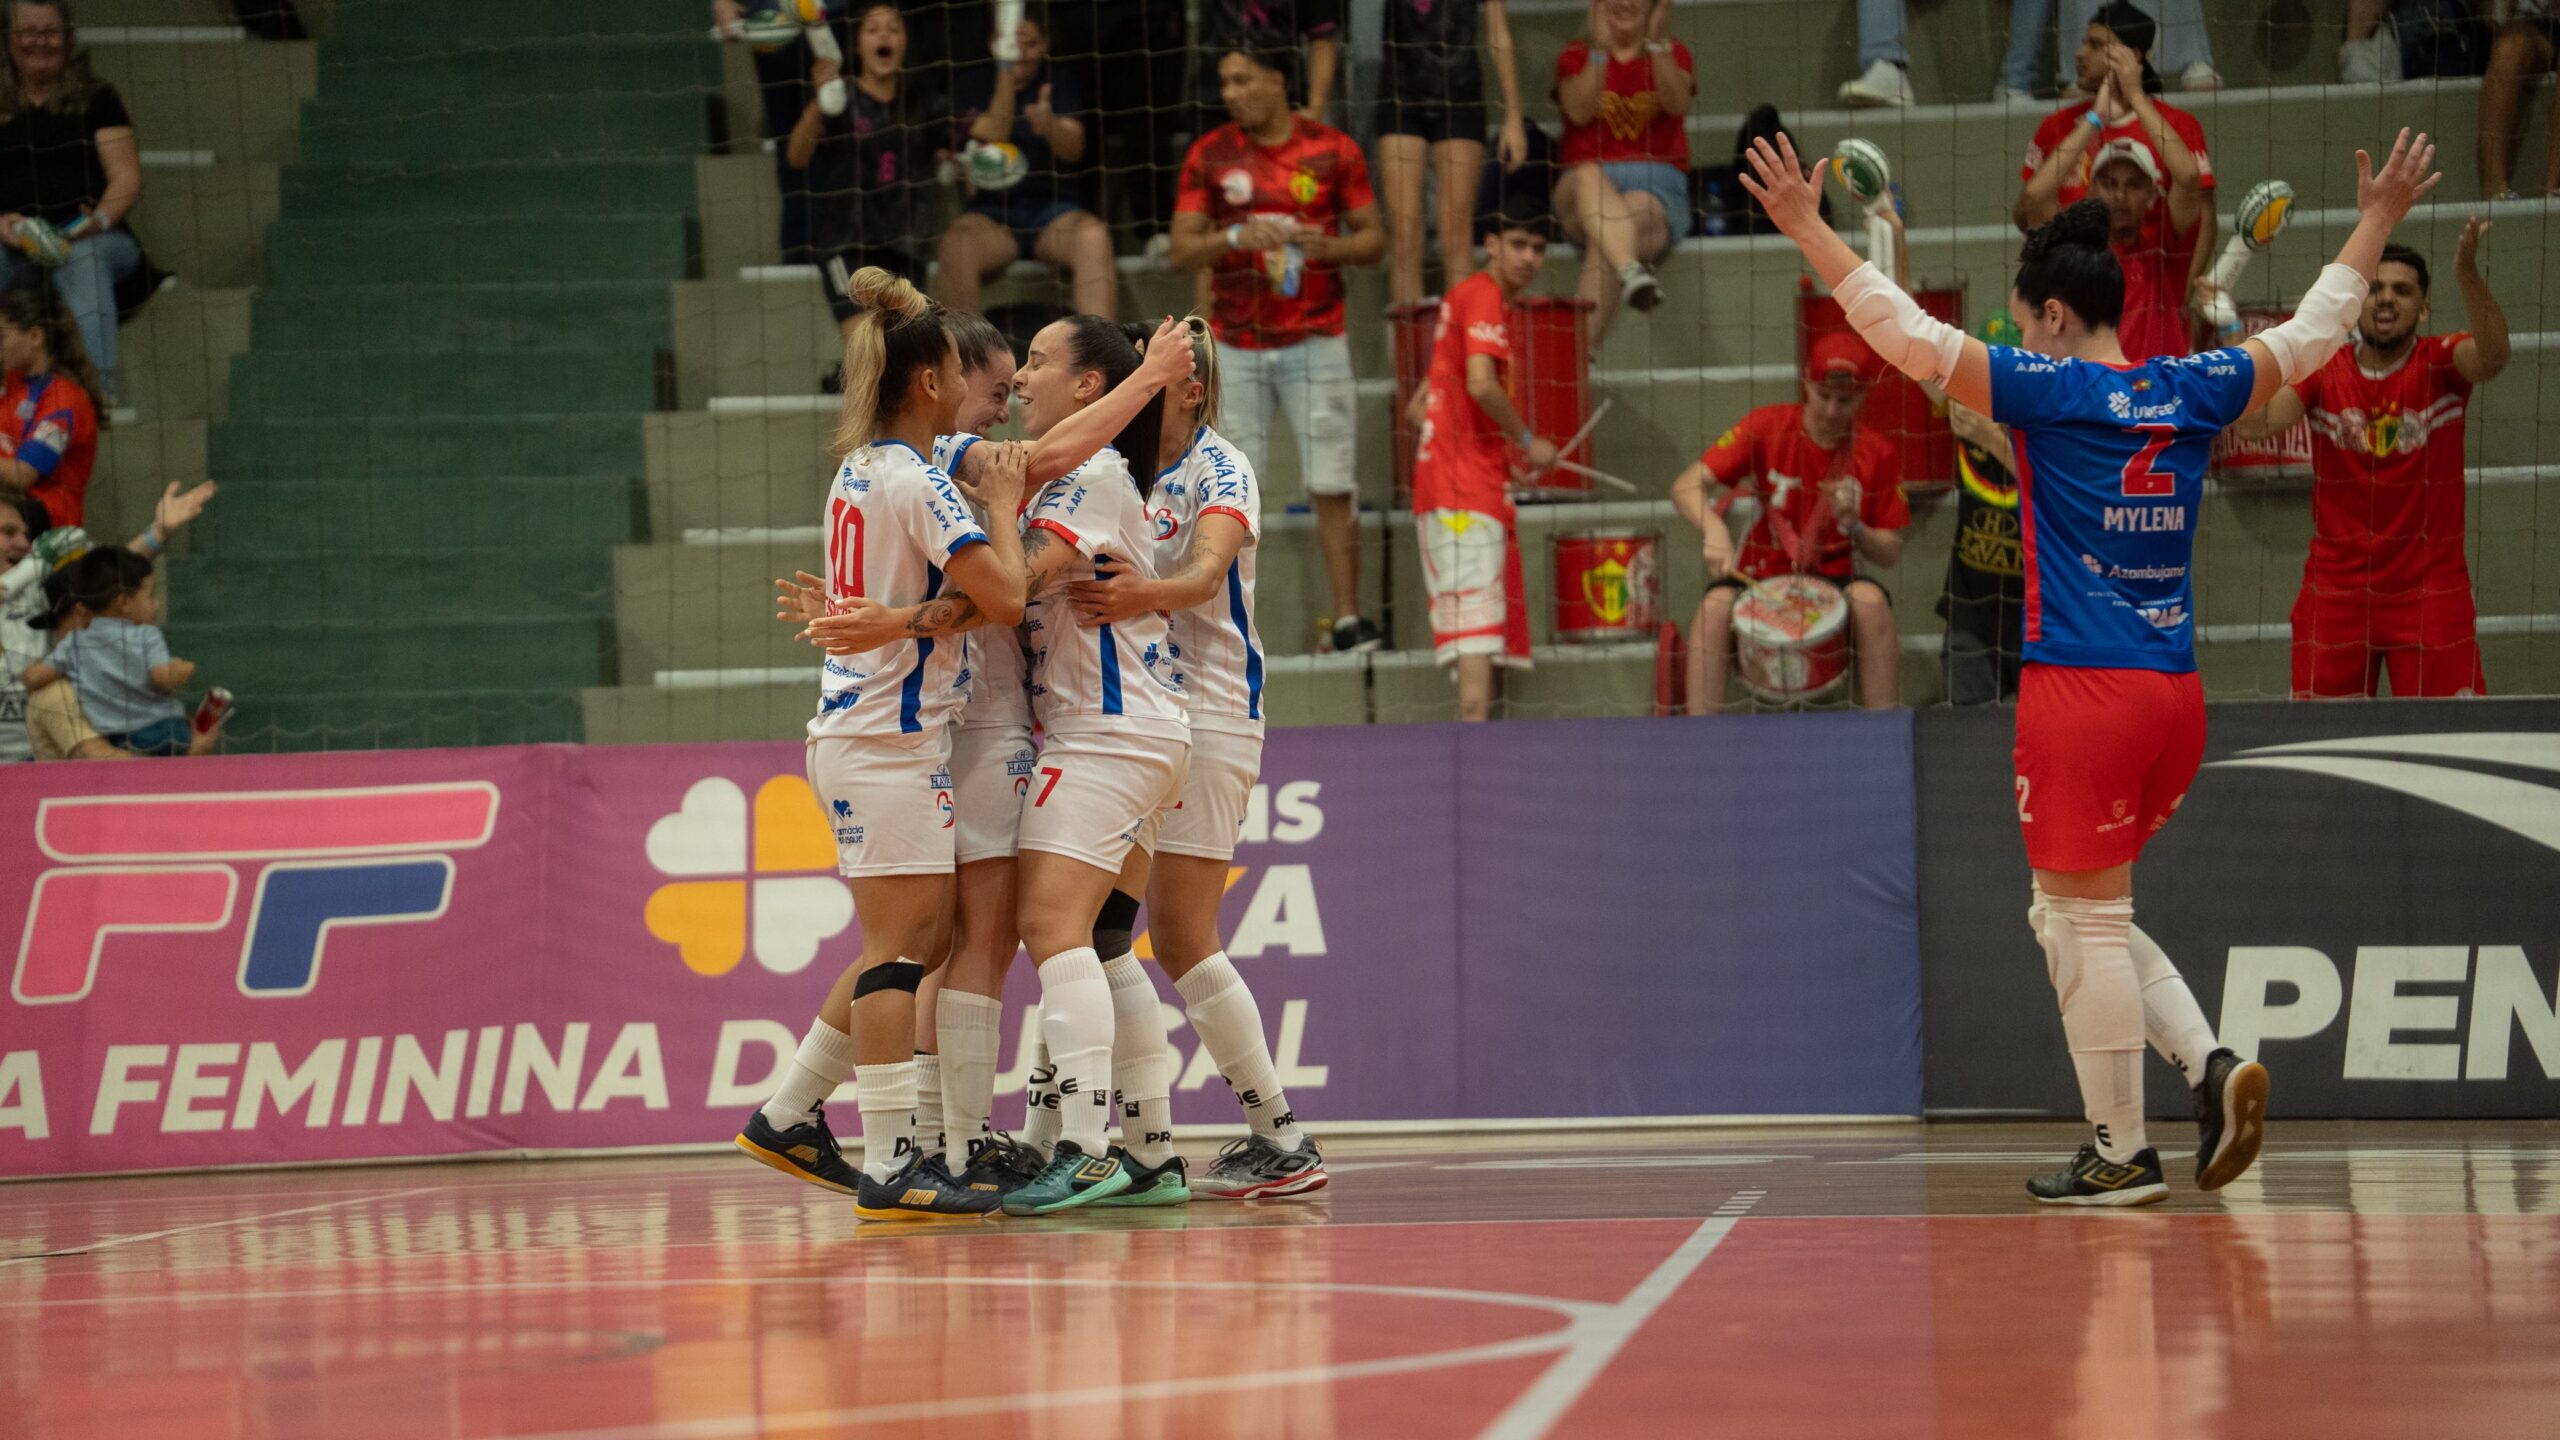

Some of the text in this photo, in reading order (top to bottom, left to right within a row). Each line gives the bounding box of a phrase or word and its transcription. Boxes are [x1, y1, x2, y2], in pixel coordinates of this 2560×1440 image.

[1202, 445, 1238, 499] HAVAN
[2121, 422, 2176, 496] 2
[933, 507, 951, 532] APX
[1070, 486, 1088, 507] APX
[2104, 506, 2185, 531] MYLENA
[830, 497, 865, 599] 10
[1007, 763, 1032, 775] HAVA
[1034, 766, 1063, 808] 7
[2016, 775, 2033, 823] 2
[2217, 944, 2560, 1080] PEN
[89, 1022, 670, 1134] FEMININA
